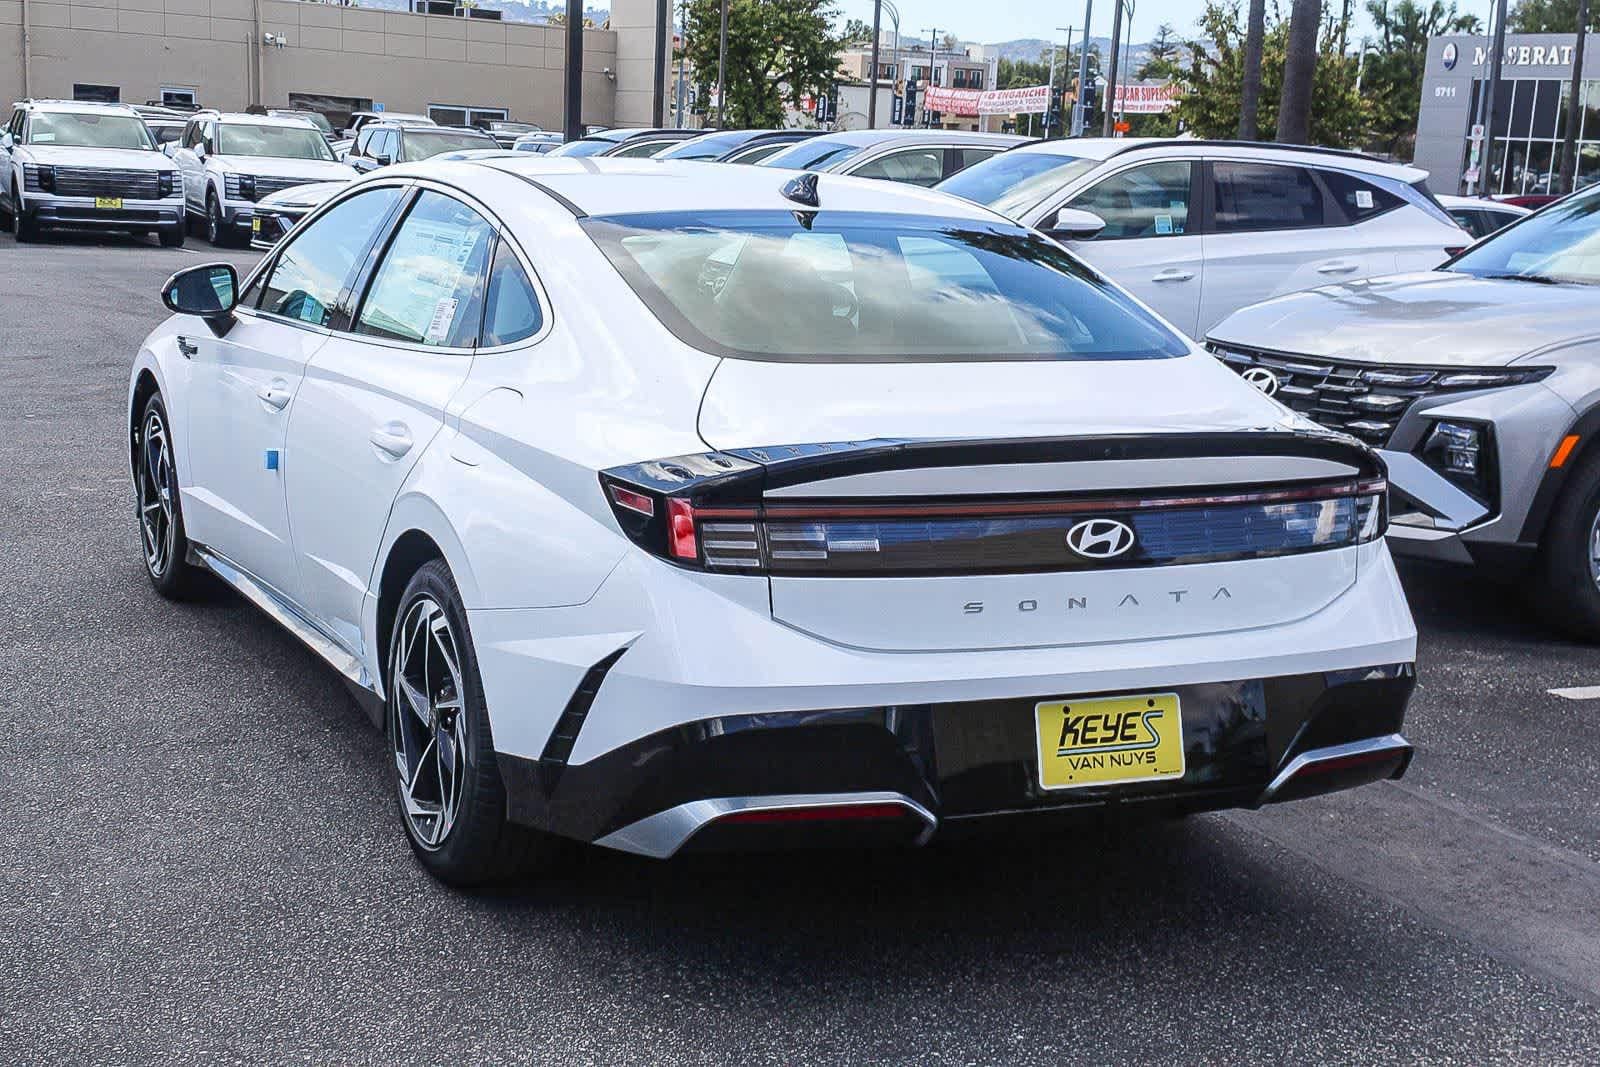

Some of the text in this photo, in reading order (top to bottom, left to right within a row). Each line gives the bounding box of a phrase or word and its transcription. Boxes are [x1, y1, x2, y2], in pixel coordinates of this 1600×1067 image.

[1472, 45, 1574, 66] MSERAT
[963, 586, 1232, 614] SONATA
[1057, 709, 1165, 748] KEYES
[1068, 751, 1157, 770] VAN NUYS
